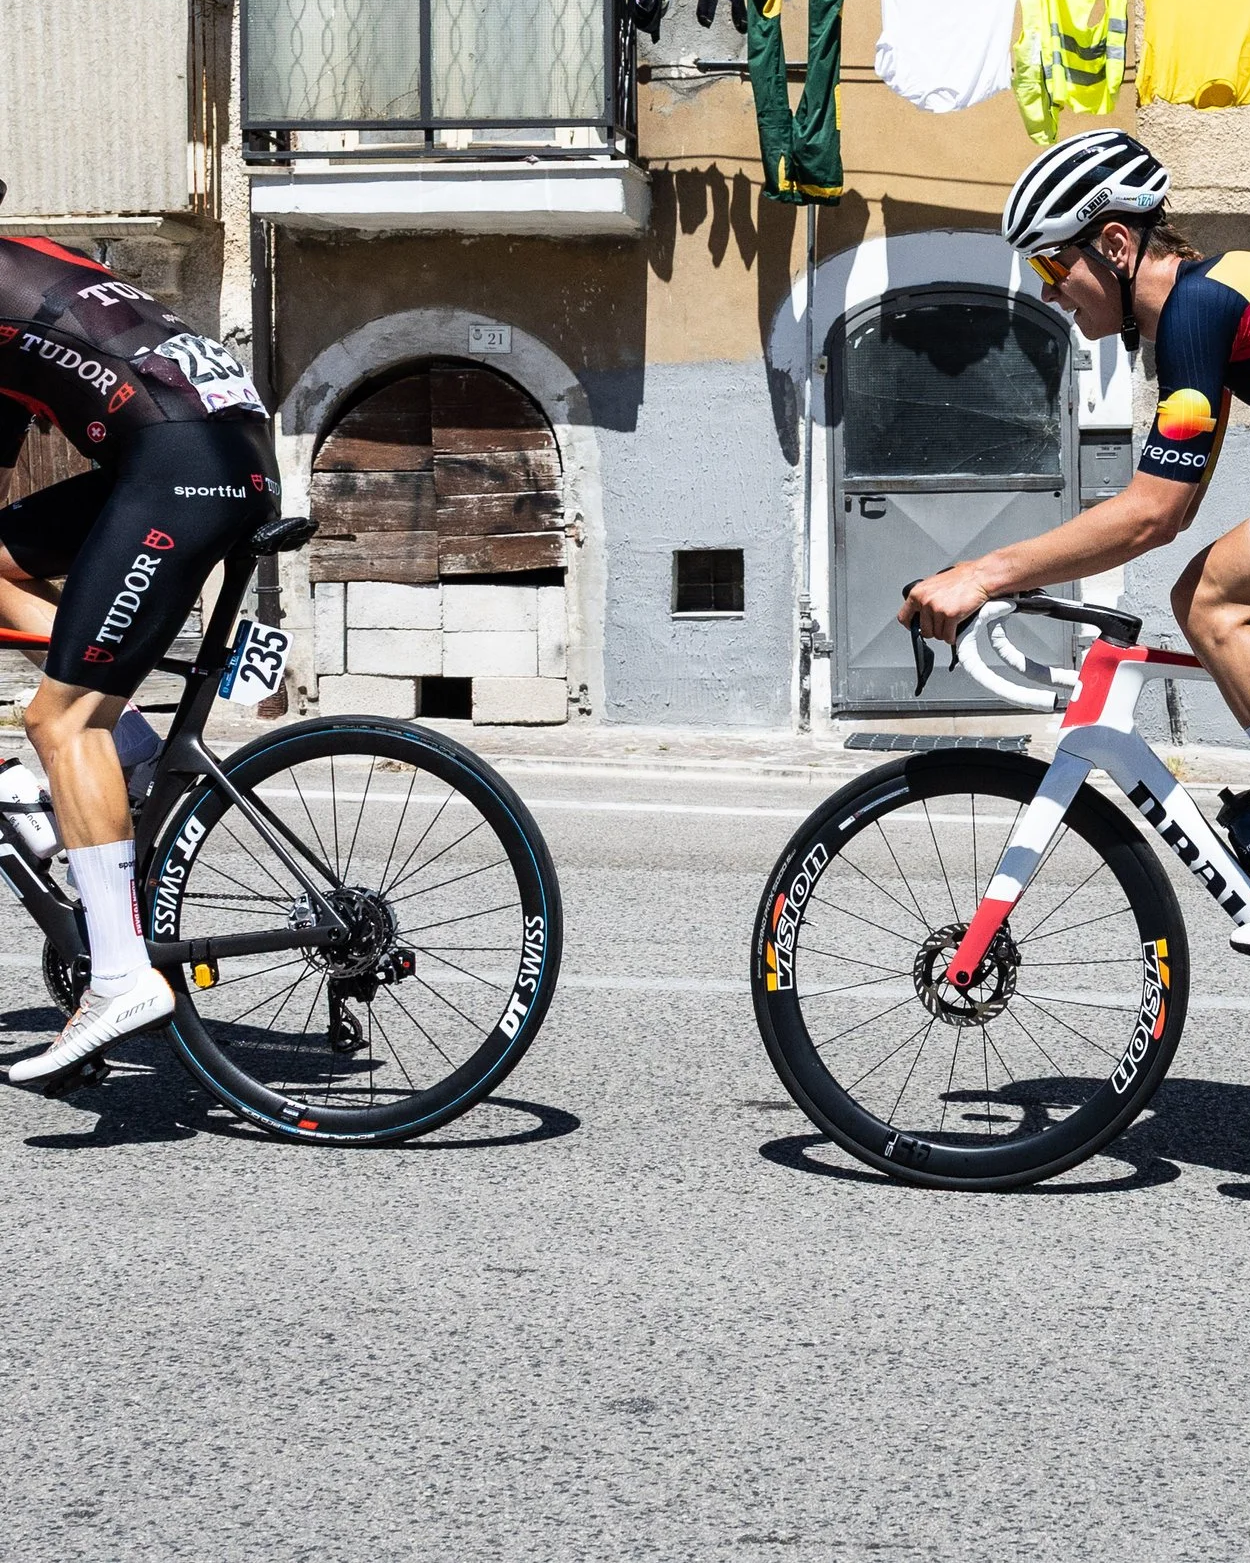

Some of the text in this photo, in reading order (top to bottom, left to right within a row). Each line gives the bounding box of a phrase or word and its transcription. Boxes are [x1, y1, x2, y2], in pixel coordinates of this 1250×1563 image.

[1081, 190, 1109, 219] ABUS
[19, 333, 118, 396] TUDOR
[487, 332, 503, 345] 21
[174, 485, 247, 499] sportful
[96, 553, 162, 646] TUDOR
[240, 628, 289, 690] 235
[154, 816, 208, 937] DT SWISS
[1126, 780, 1246, 928] DRAL
[499, 915, 546, 1040] DT SWISS
[115, 994, 159, 1025] DMT
[883, 1131, 899, 1158] SL
